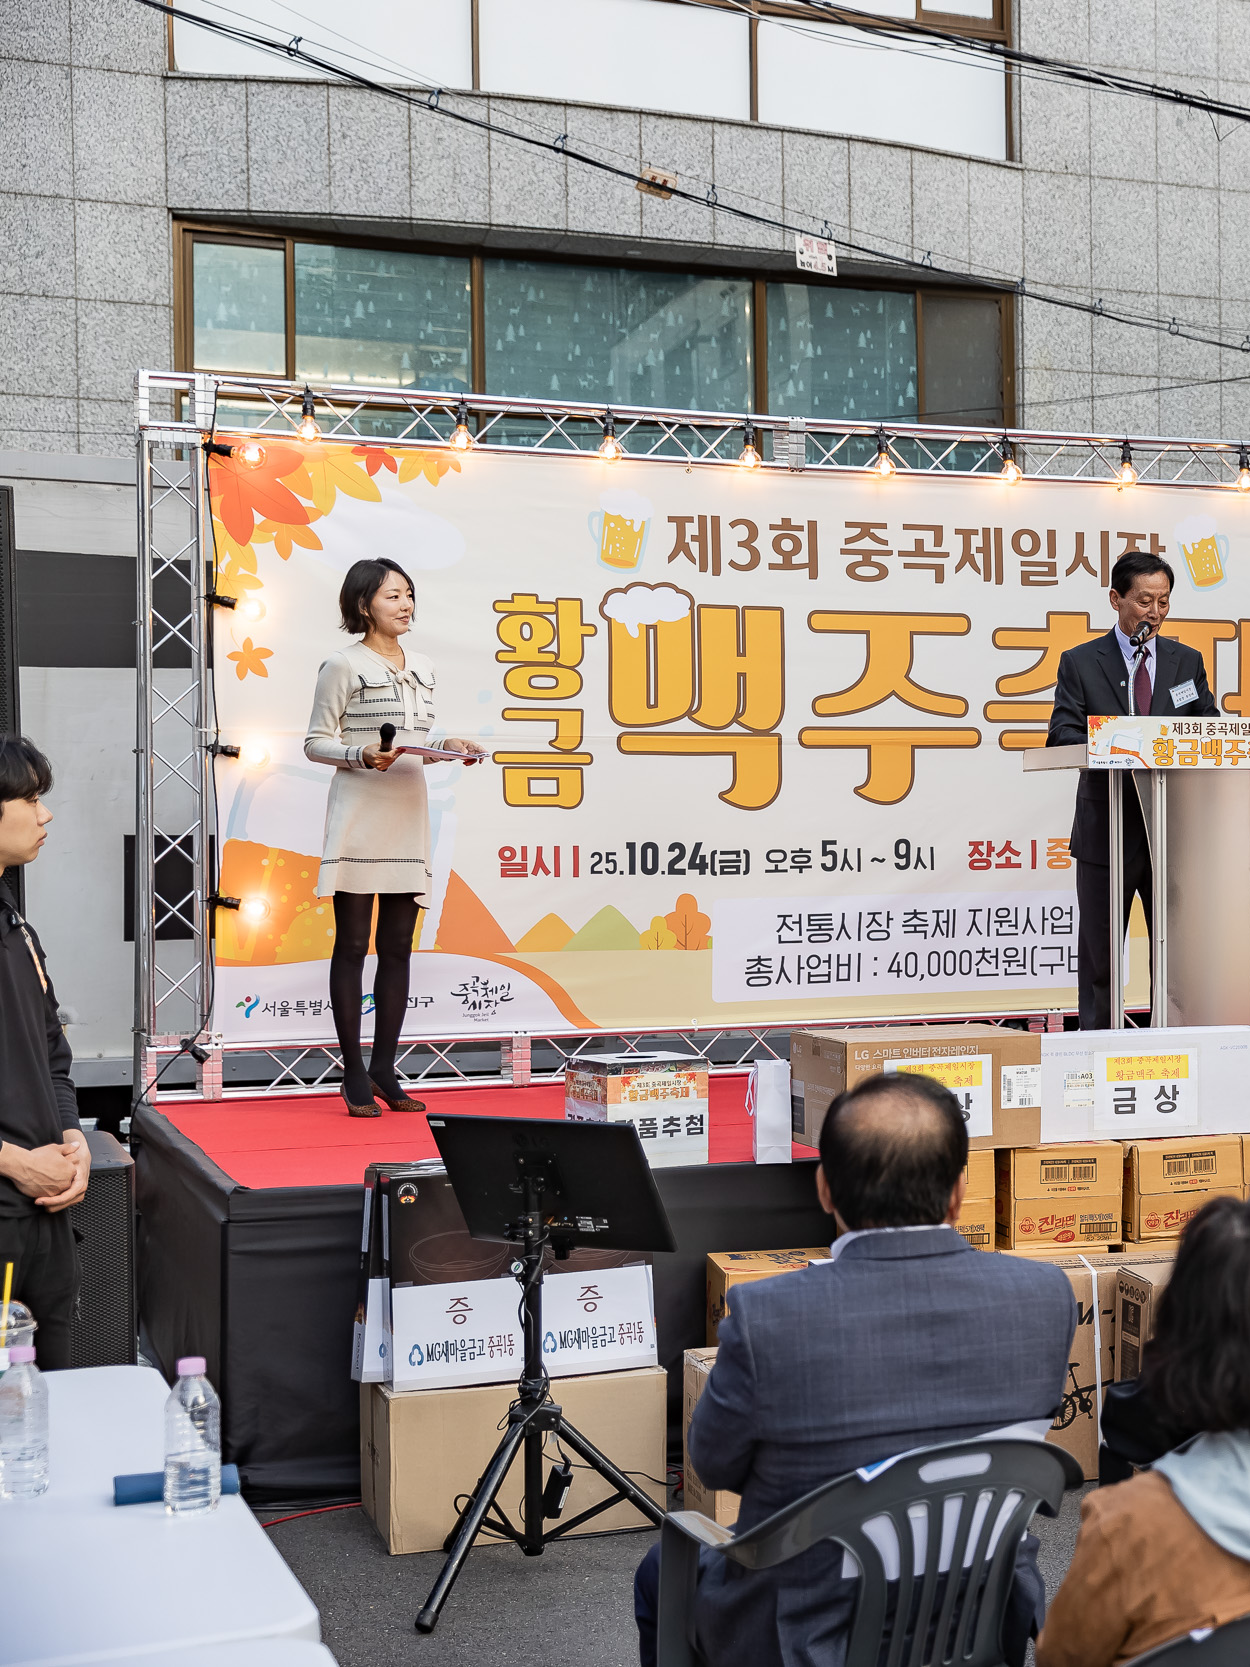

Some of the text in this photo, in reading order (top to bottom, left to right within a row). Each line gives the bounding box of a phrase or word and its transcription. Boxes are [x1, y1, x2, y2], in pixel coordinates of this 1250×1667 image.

[667, 514, 820, 580] 제3회
[1172, 722, 1203, 736] 제3회
[498, 845, 561, 878] 일시
[590, 841, 751, 877] 25.10.24(금)
[764, 848, 813, 874] 오후
[820, 839, 862, 873] 5시
[893, 838, 935, 872] 9시
[967, 839, 1022, 871] 장소
[775, 905, 1074, 945] 전통시장 축제 지원사업
[744, 952, 862, 987] 총사업비
[854, 1050, 869, 1060] LG
[873, 1047, 901, 1059] 스마트
[902, 1046, 931, 1058] 인버터
[928, 1062, 976, 1072] 중곡제일시장
[1113, 1055, 1182, 1065] 제3회 중곡제일시장
[953, 1074, 973, 1087] 축제
[1115, 1067, 1180, 1081] 황금맥주 축제
[1112, 1084, 1180, 1115] 금 상
[615, 1113, 704, 1139] 품추첨
[1038, 1213, 1076, 1235] 진라면
[445, 1296, 474, 1325] 증
[576, 1285, 603, 1313] 증
[426, 1333, 515, 1364] MG새마을금고 중곡1동
[558, 1320, 645, 1352] MG새마을금고 중곡1동
